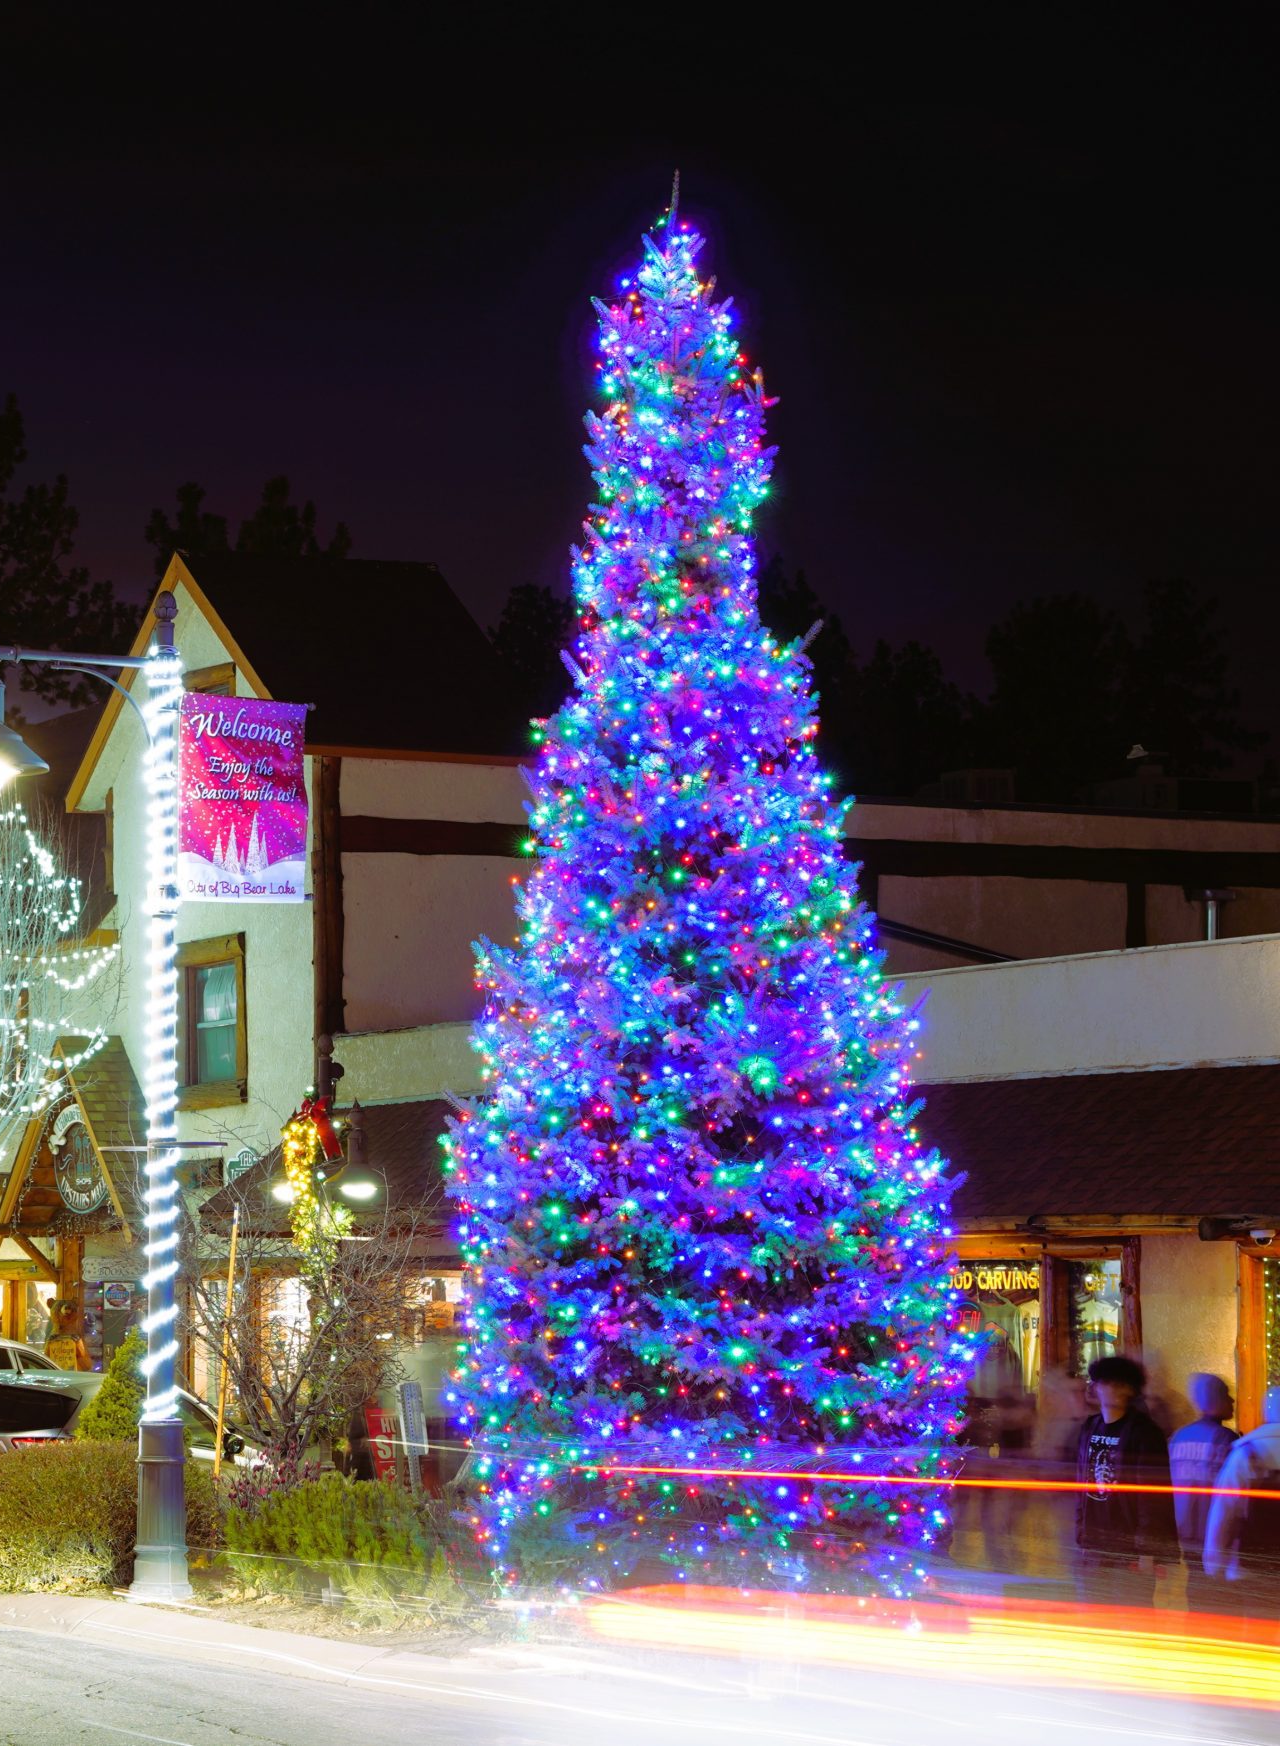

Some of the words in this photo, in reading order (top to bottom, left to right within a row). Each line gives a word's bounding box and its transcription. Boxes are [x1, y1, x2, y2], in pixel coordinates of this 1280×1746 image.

[209, 756, 250, 782] Enjoy
[255, 757, 273, 775] the
[190, 782, 239, 799] Season
[243, 782, 273, 800] with
[277, 788, 296, 801] us!
[187, 880, 206, 896] City
[209, 881, 218, 897] of
[220, 881, 239, 898] Big
[241, 882, 266, 894] Bear
[270, 880, 296, 895] Lake
[239, 1153, 253, 1166] THE
[948, 1271, 973, 1289] OD
[977, 1271, 1039, 1289] CARVING
